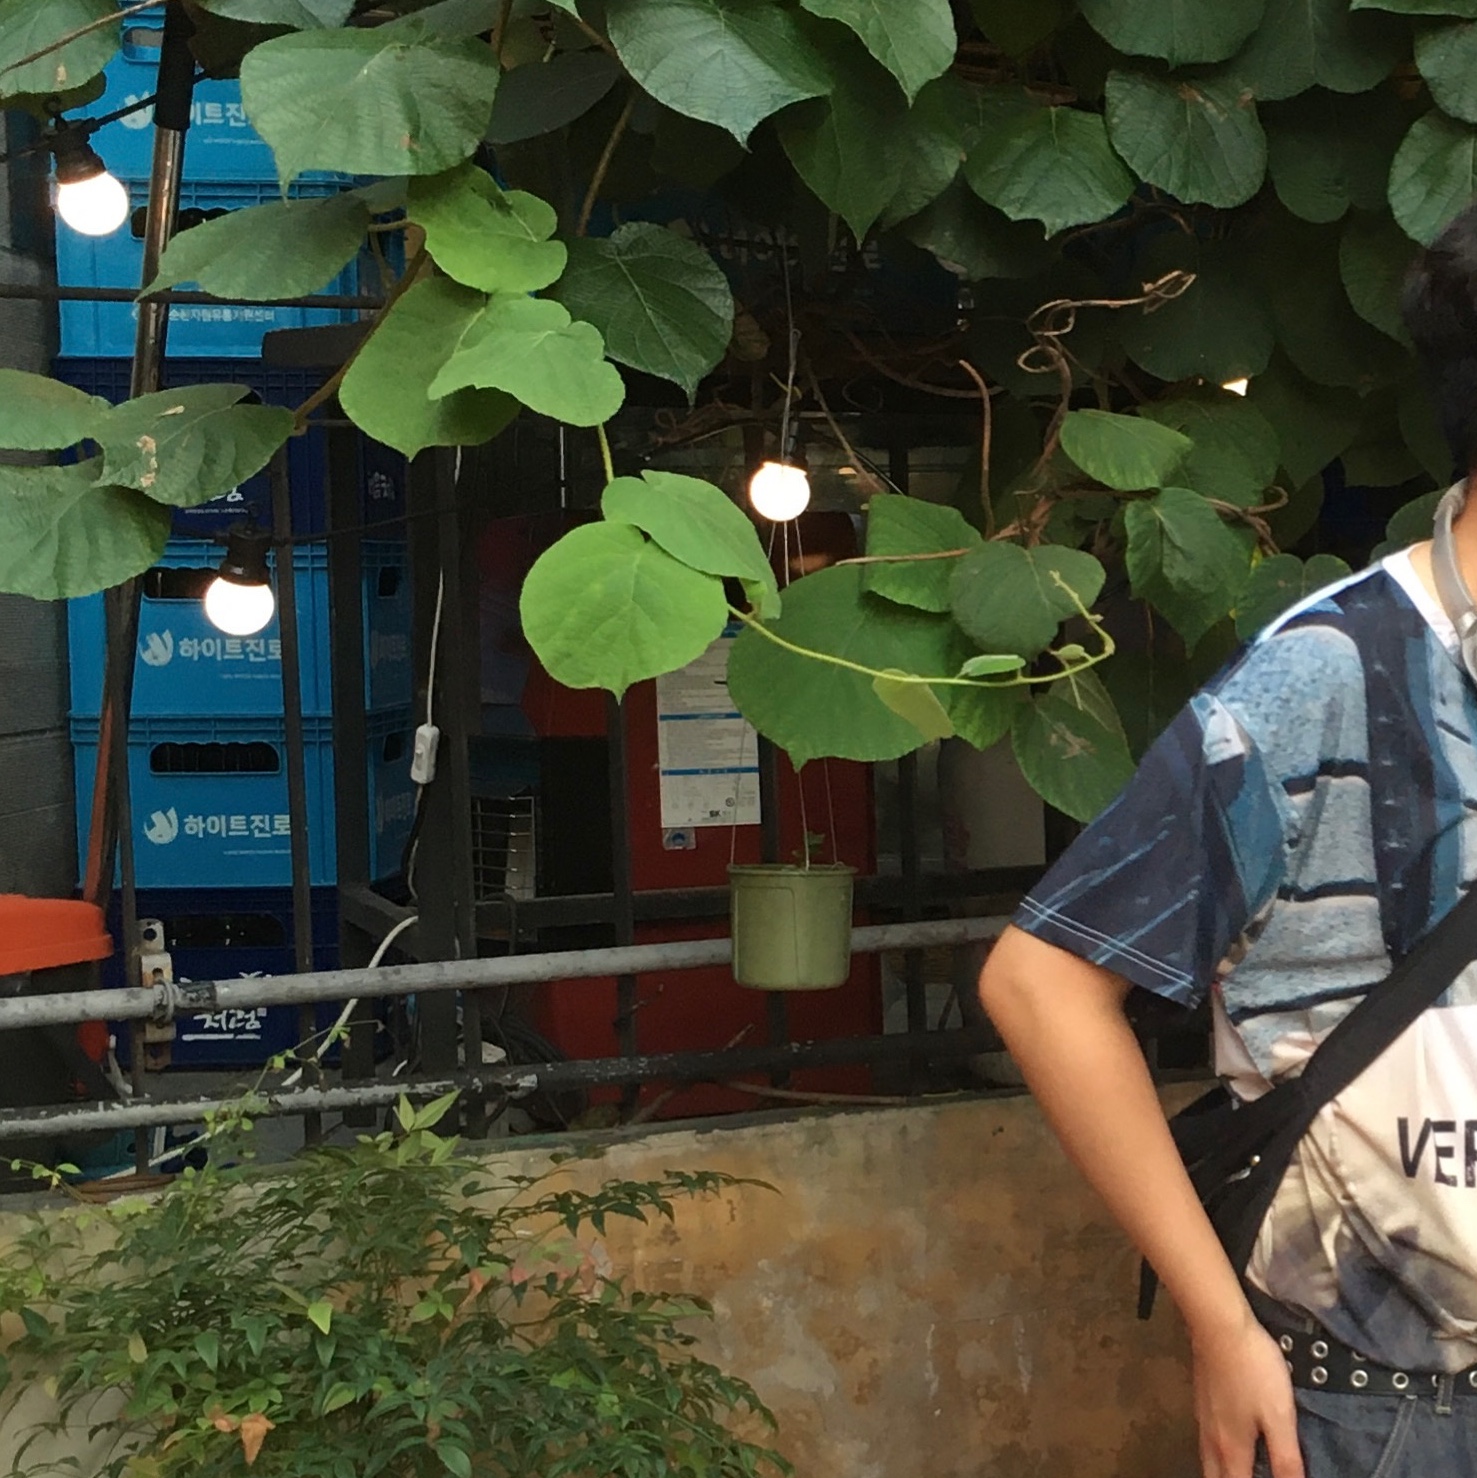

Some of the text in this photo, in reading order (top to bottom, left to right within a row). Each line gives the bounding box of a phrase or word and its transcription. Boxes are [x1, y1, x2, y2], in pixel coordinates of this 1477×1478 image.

[190, 102, 250, 127] 이트진
[179, 637, 282, 663] 하이트진로
[184, 814, 292, 838] 하이트진로
